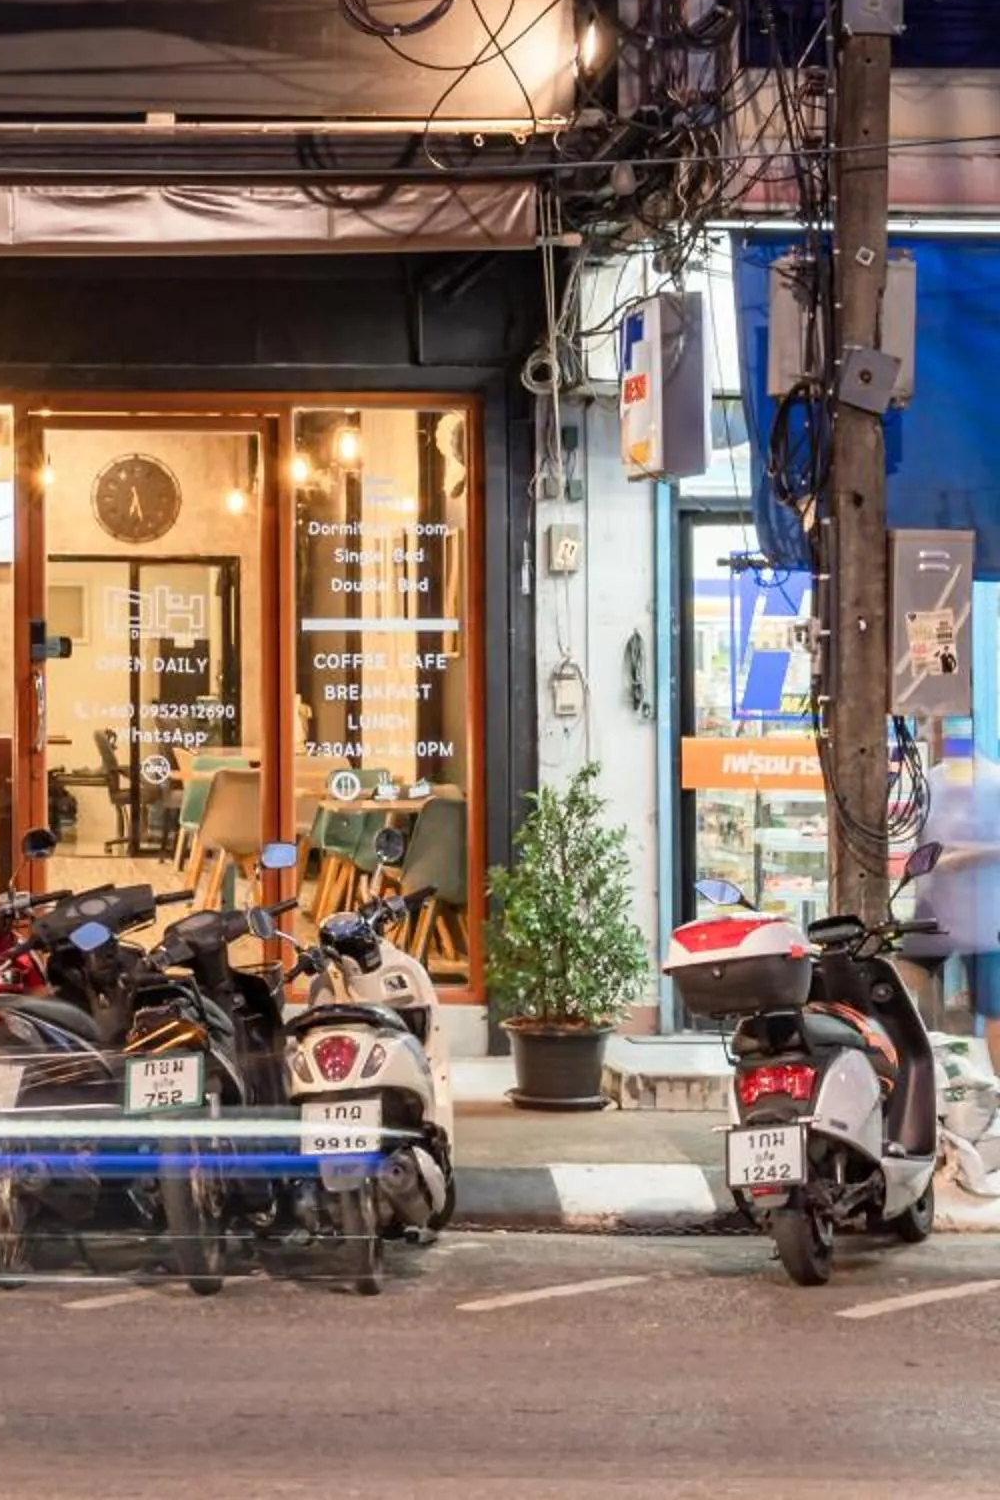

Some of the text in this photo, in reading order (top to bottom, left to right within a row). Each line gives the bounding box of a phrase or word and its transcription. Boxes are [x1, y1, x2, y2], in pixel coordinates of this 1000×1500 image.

[153, 656, 209, 673] DAILY
[313, 653, 387, 669] COFFEE
[144, 1090, 183, 1108] 752
[313, 1137, 367, 1150] 9916
[744, 1163, 791, 1181] 1242
